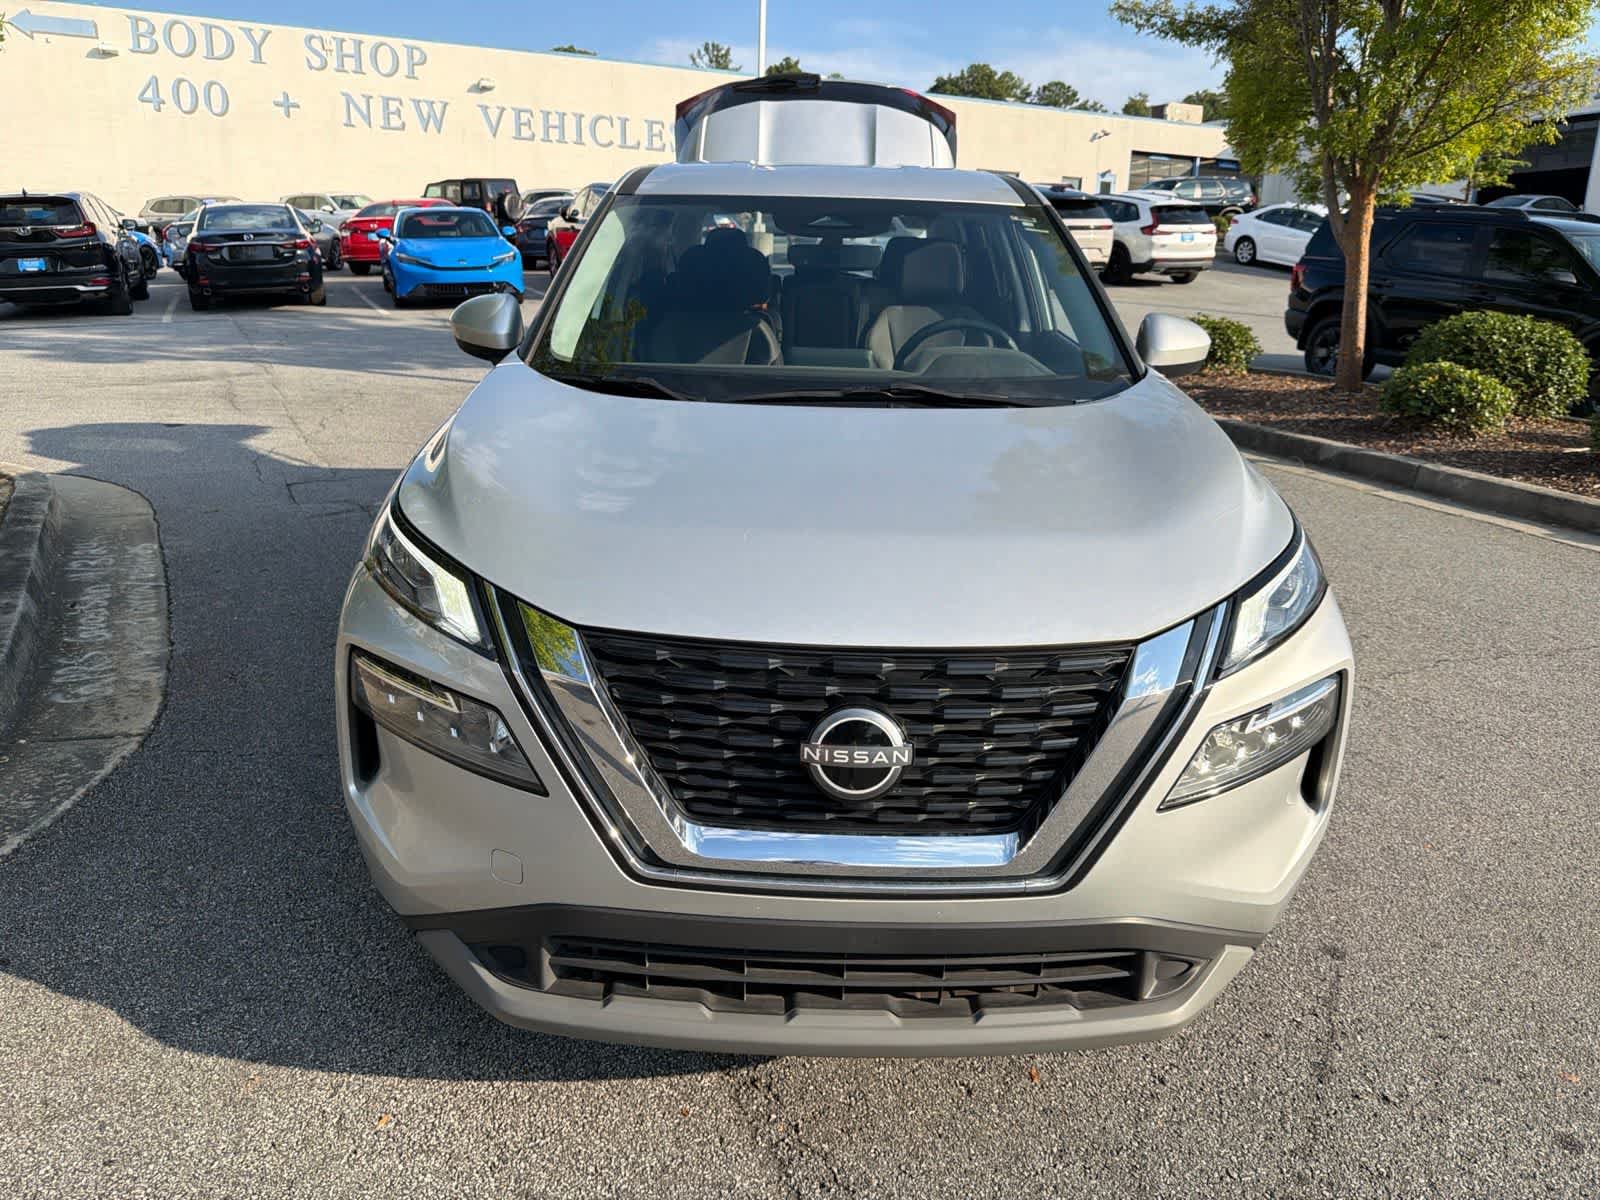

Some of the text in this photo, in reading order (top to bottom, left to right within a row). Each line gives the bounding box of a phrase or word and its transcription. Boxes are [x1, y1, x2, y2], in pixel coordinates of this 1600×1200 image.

[126, 14, 427, 80] BODY SHOP
[137, 74, 230, 117] 400
[340, 91, 449, 134] NEW
[477, 104, 675, 152] VEHICLE
[803, 746, 909, 764] NISSAN
